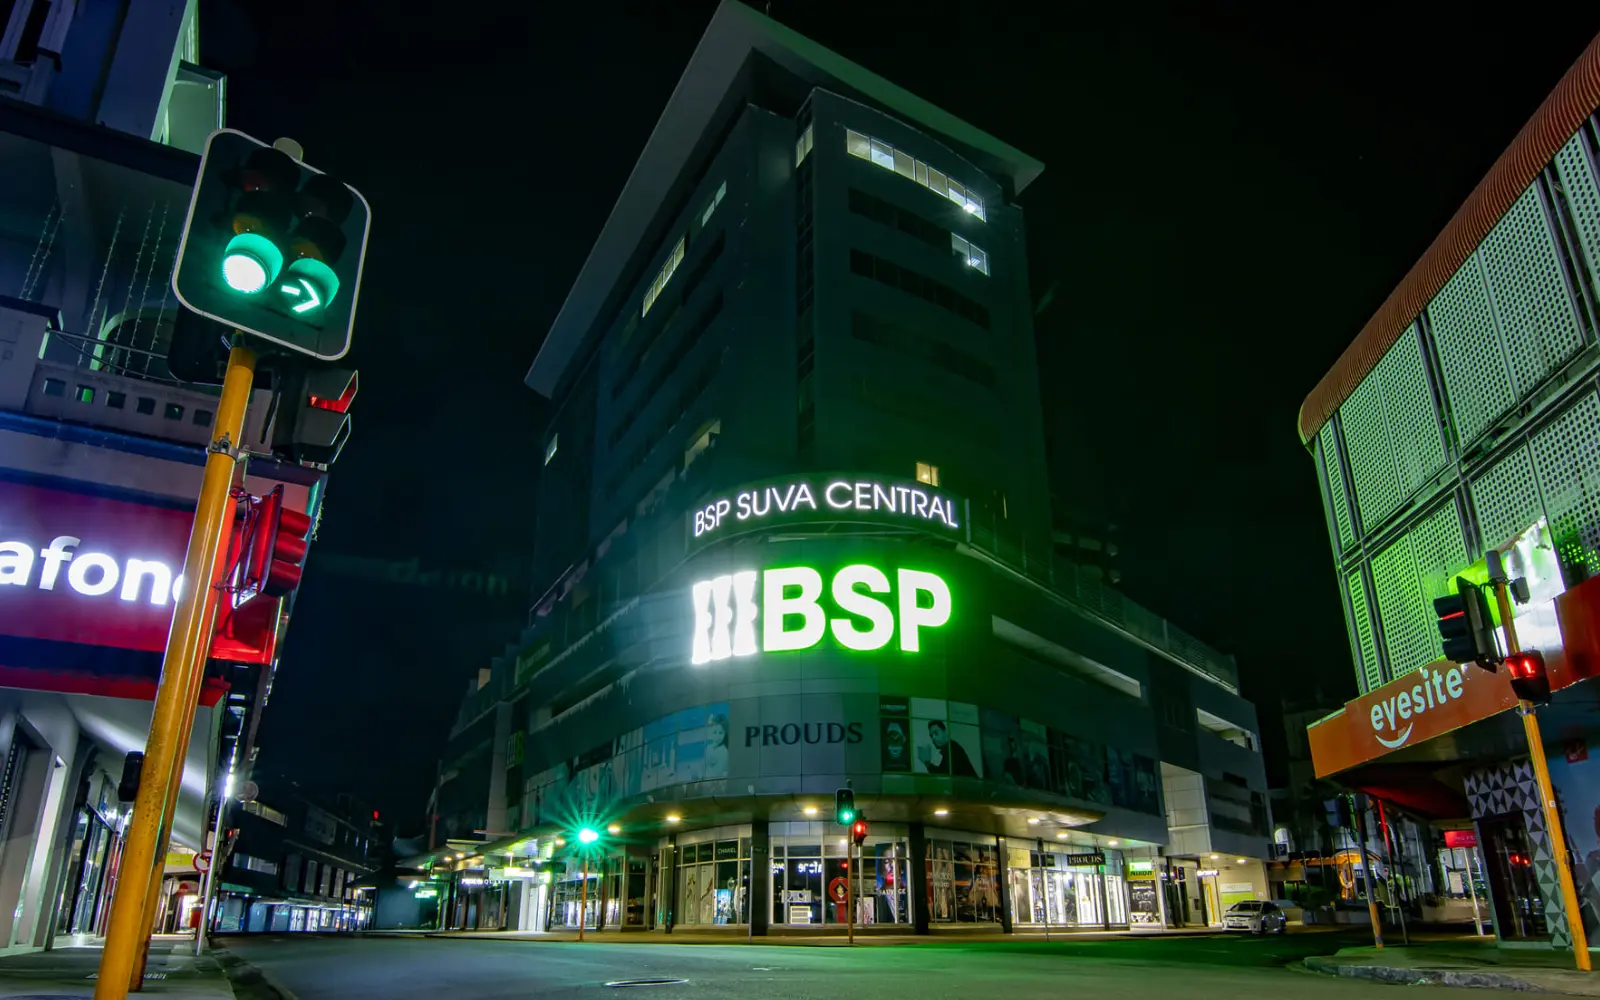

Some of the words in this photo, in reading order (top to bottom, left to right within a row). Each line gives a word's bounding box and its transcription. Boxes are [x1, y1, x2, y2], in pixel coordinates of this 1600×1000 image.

[694, 500, 730, 537] BSP
[736, 485, 817, 520] SUVA
[825, 482, 959, 528] CENTRAL
[0, 535, 183, 605] afon
[763, 564, 952, 652] BSP
[1371, 668, 1463, 731] eyesite
[744, 722, 863, 748] PROUDS
[1068, 855, 1102, 865] PROUDS
